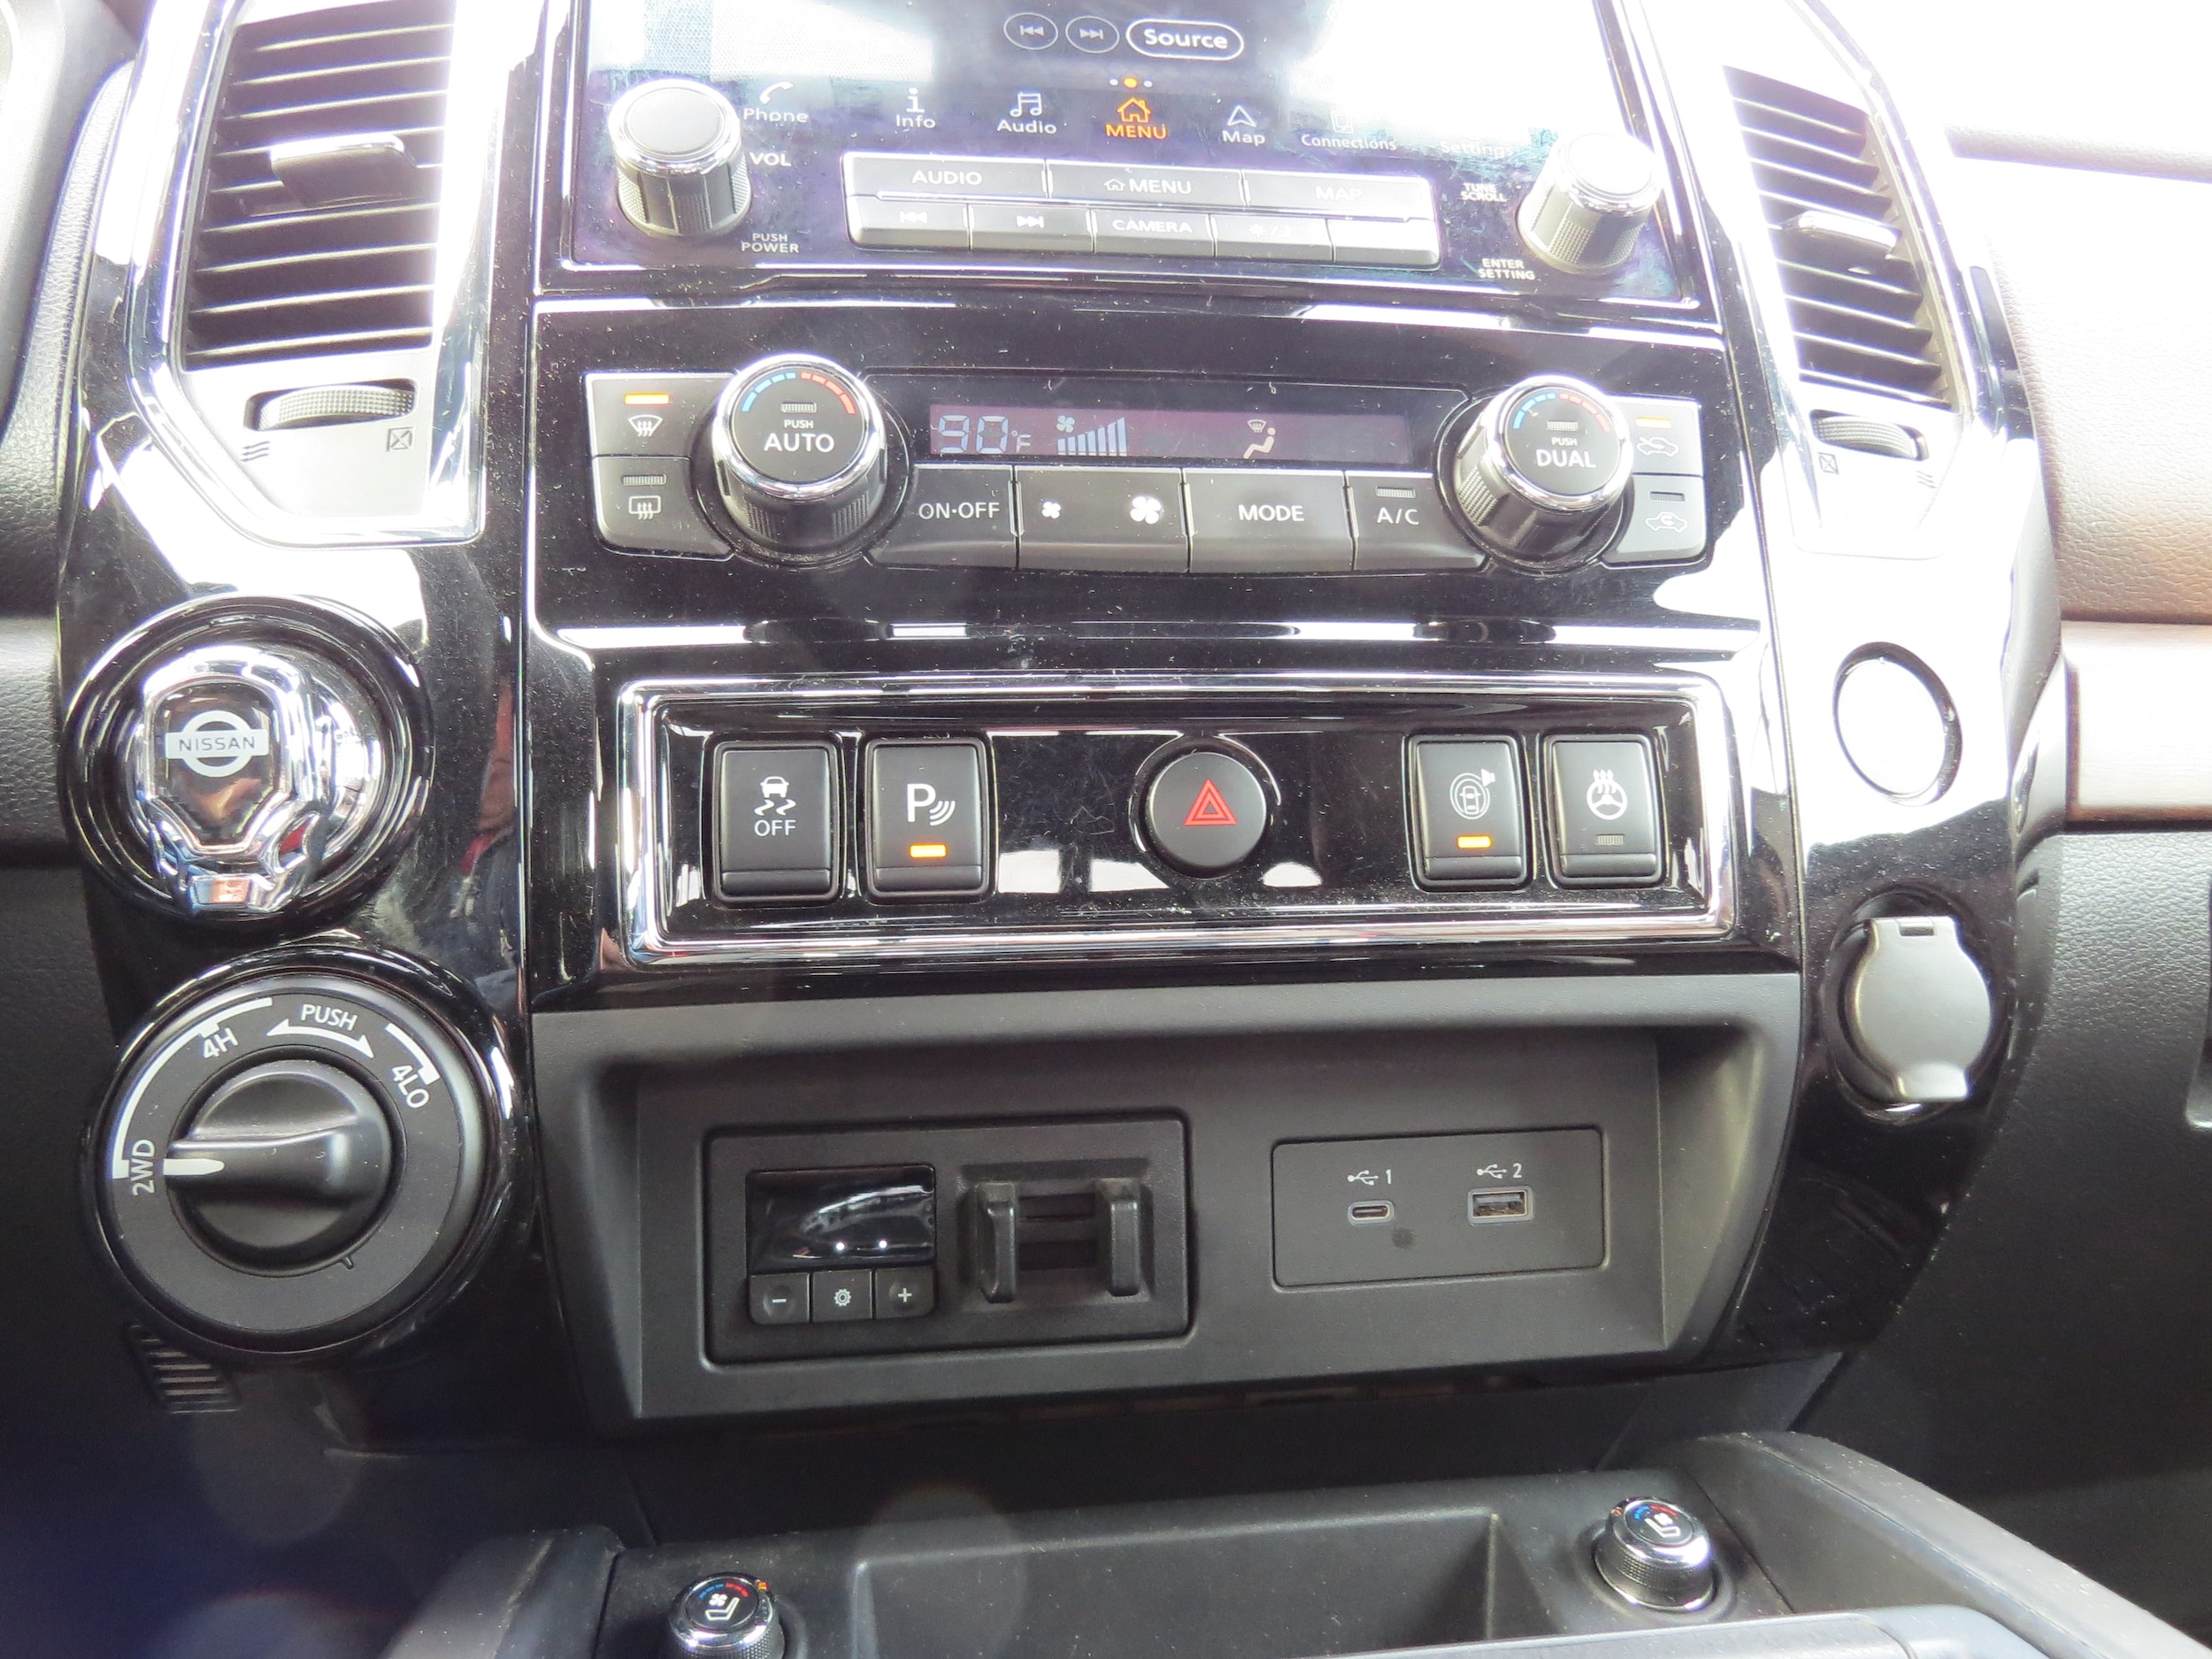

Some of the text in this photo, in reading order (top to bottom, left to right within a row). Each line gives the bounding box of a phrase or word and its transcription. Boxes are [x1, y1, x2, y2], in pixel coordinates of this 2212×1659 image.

[1143, 27, 1228, 50] Source
[742, 107, 808, 125] Phone
[895, 115, 936, 130] Info
[996, 119, 1057, 135] Audio
[1105, 124, 1168, 140] MENU
[1222, 130, 1265, 146] Map
[1302, 134, 1396, 151] Connections
[1440, 141, 1513, 159] Settings
[749, 151, 791, 167] VOL
[911, 170, 983, 186] AUDIO
[1128, 178, 1192, 195] MENU
[1315, 186, 1362, 202] MAP
[1463, 182, 1497, 193] TUNE
[1460, 191, 1508, 203] SCROLL
[1112, 219, 1193, 234] CAMERA
[752, 233, 788, 243] PUSH
[741, 242, 799, 254] POWER
[1482, 258, 1525, 271] ENTER
[1478, 266, 1535, 281] SETTING
[784, 419, 814, 429] PUSH
[764, 433, 834, 454] AUTO
[1551, 436, 1578, 447] PUSH
[1535, 449, 1596, 470] DUAL
[1238, 503, 1305, 523] MODE
[1376, 507, 1419, 526] A/C
[178, 733, 256, 753] NISSAN
[753, 818, 797, 837] OFF
[300, 1003, 358, 1032] PUSH
[202, 1027, 239, 1060] 4H
[391, 1063, 431, 1110] 4LO
[131, 1138, 156, 1196] 2WD
[1511, 1163, 1523, 1179] 2
[1386, 1169, 1393, 1185] 1
